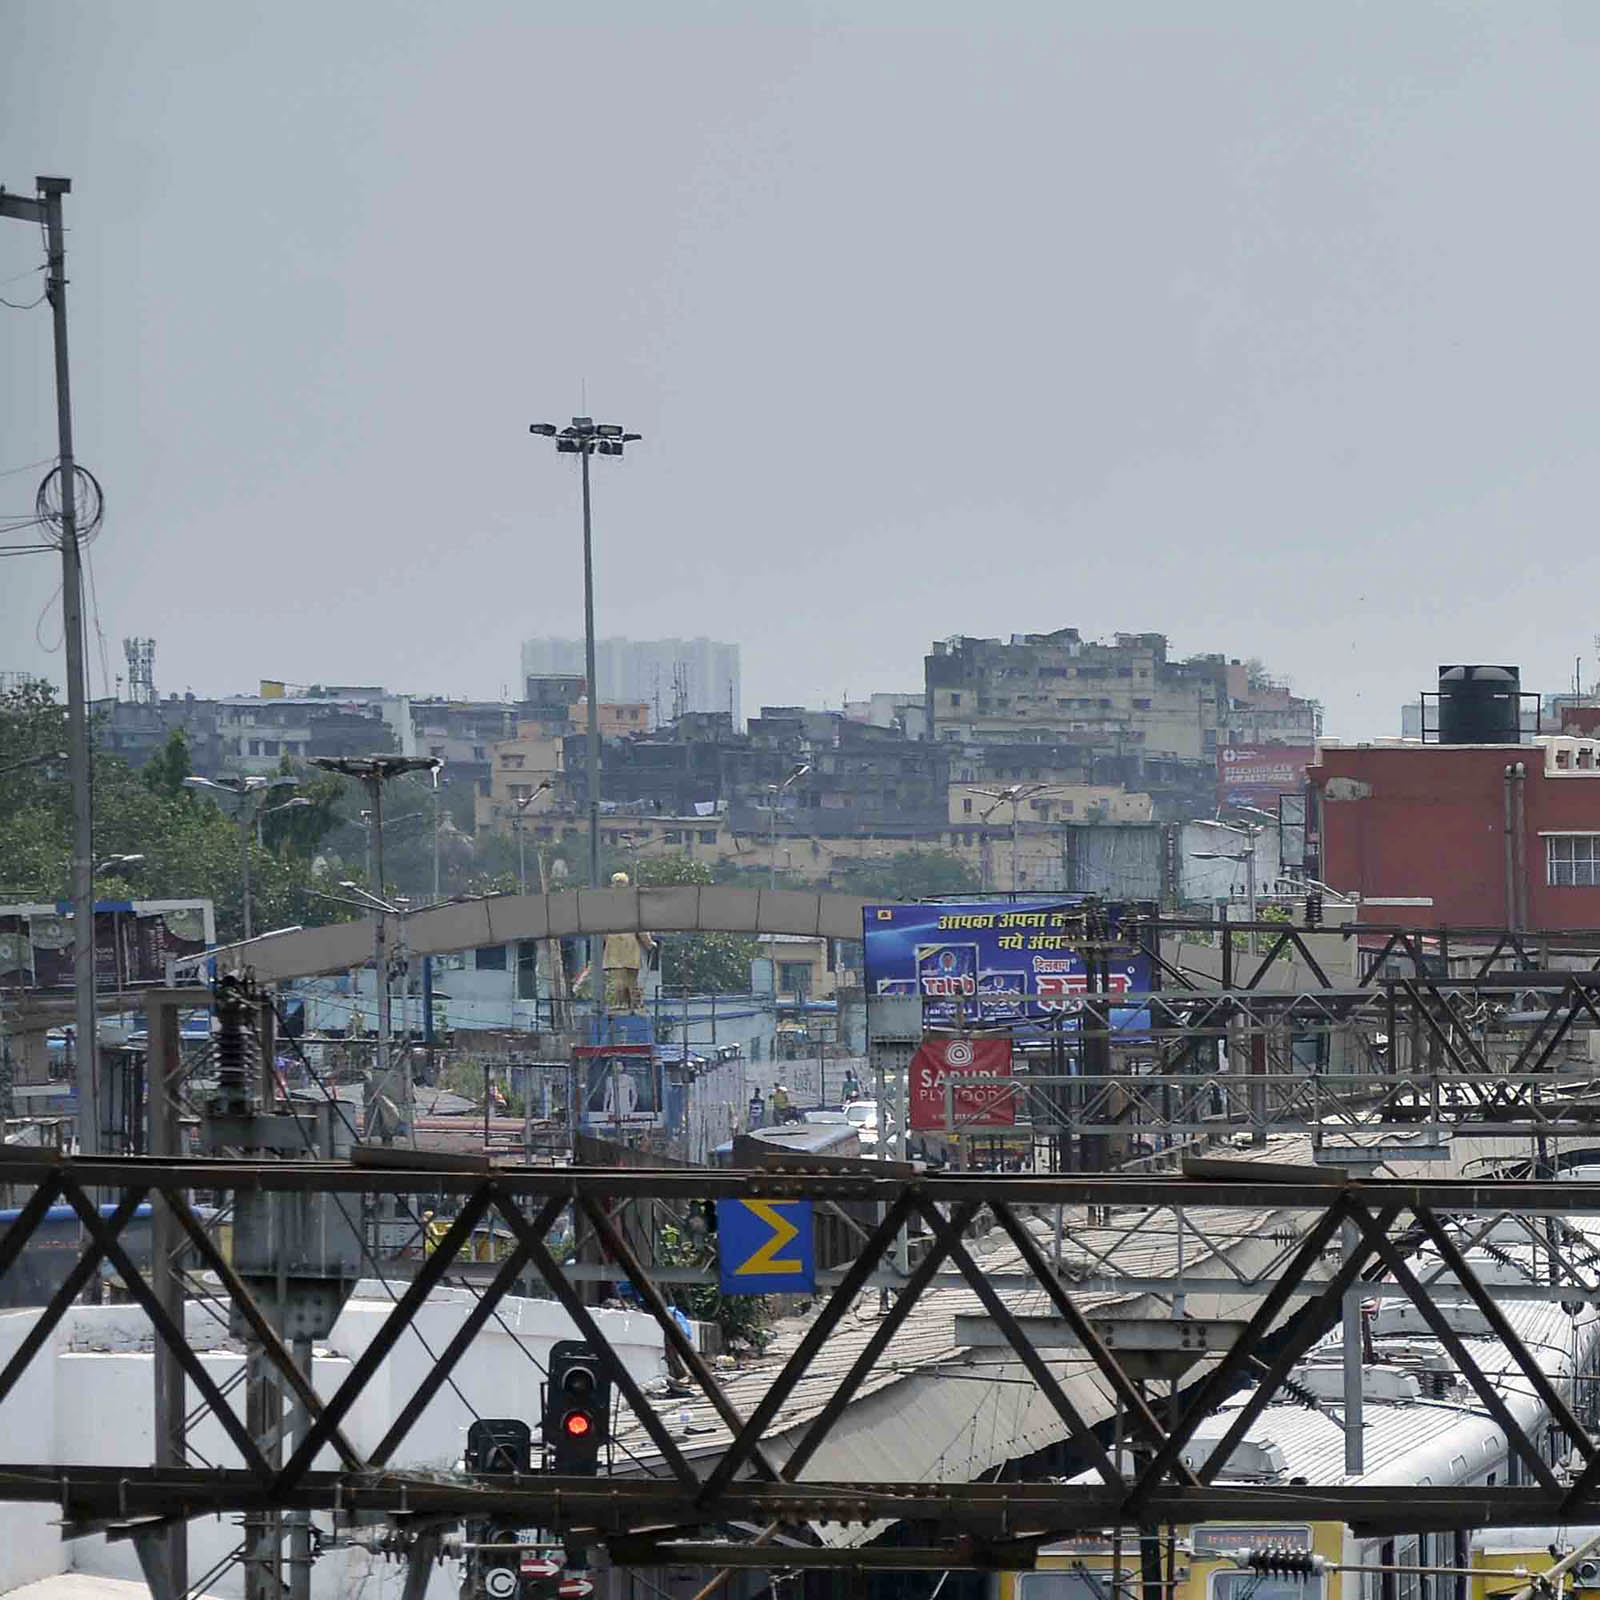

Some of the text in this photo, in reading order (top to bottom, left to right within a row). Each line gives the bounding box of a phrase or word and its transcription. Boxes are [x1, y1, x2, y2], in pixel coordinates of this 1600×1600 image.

[937, 913, 995, 930] आपका
[998, 912, 1046, 929] अपना
[998, 933, 1023, 950] नये
[920, 1088, 1000, 1102] PLYOOD
